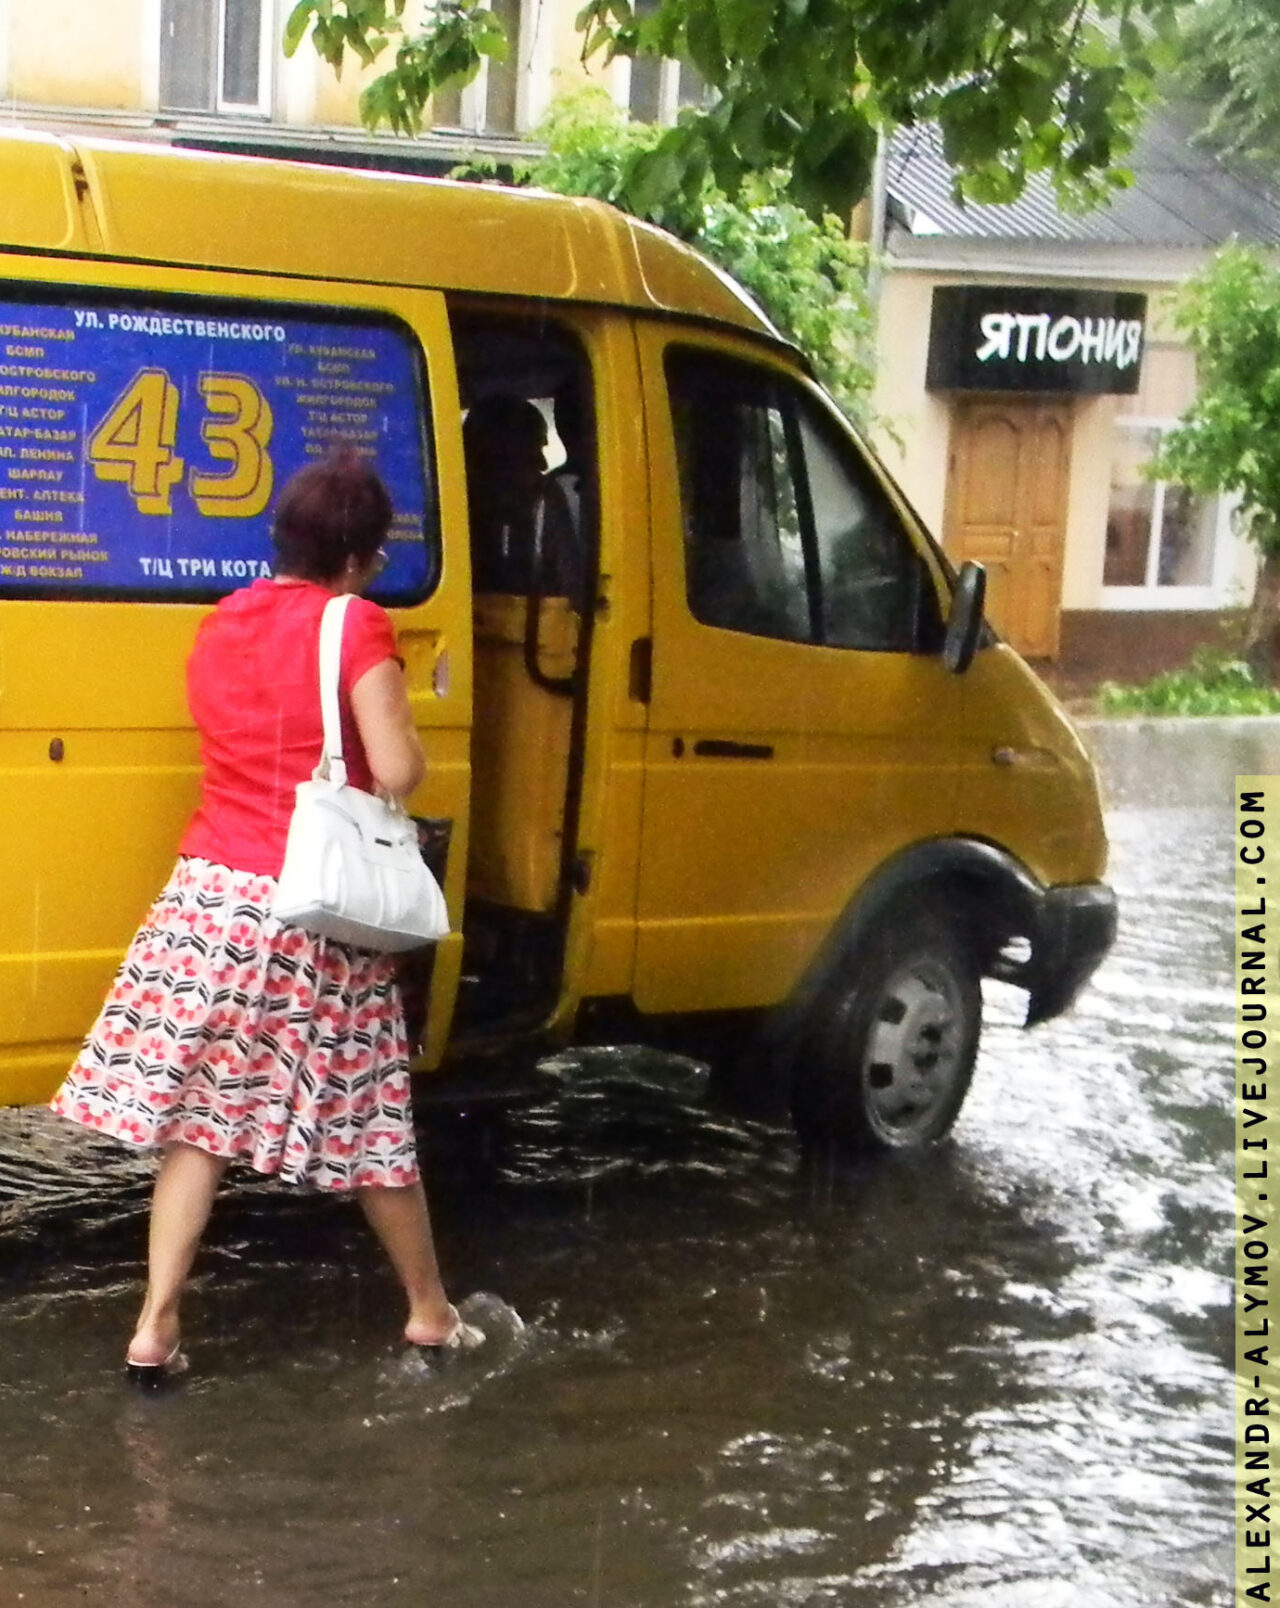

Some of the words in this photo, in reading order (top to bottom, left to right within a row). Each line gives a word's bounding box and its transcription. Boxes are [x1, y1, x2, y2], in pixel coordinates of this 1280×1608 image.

[74, 310, 104, 329] УЛ.
[108, 313, 285, 342] РОЖДЕСТВЕНСКОГО
[976, 313, 1141, 370] ЯПОНИЯ
[6, 345, 45, 358] БСМП
[0, 365, 96, 383] ОСТРОВСКОГО
[22, 407, 66, 420] АСТОР
[88, 367, 273, 518] 43
[20, 448, 74, 461] ЛЕНИНА
[33, 490, 84, 503] АПТЕКА
[14, 509, 64, 522] БАШНЯ
[6, 530, 98, 545] НАБЕРЕЖНАЯ
[61, 549, 109, 562] РЫНОК
[30, 565, 84, 579] ВОКЗАЛ
[139, 557, 173, 579] Т/Ц
[177, 558, 215, 577] ТРИ
[222, 559, 272, 578] КОТА
